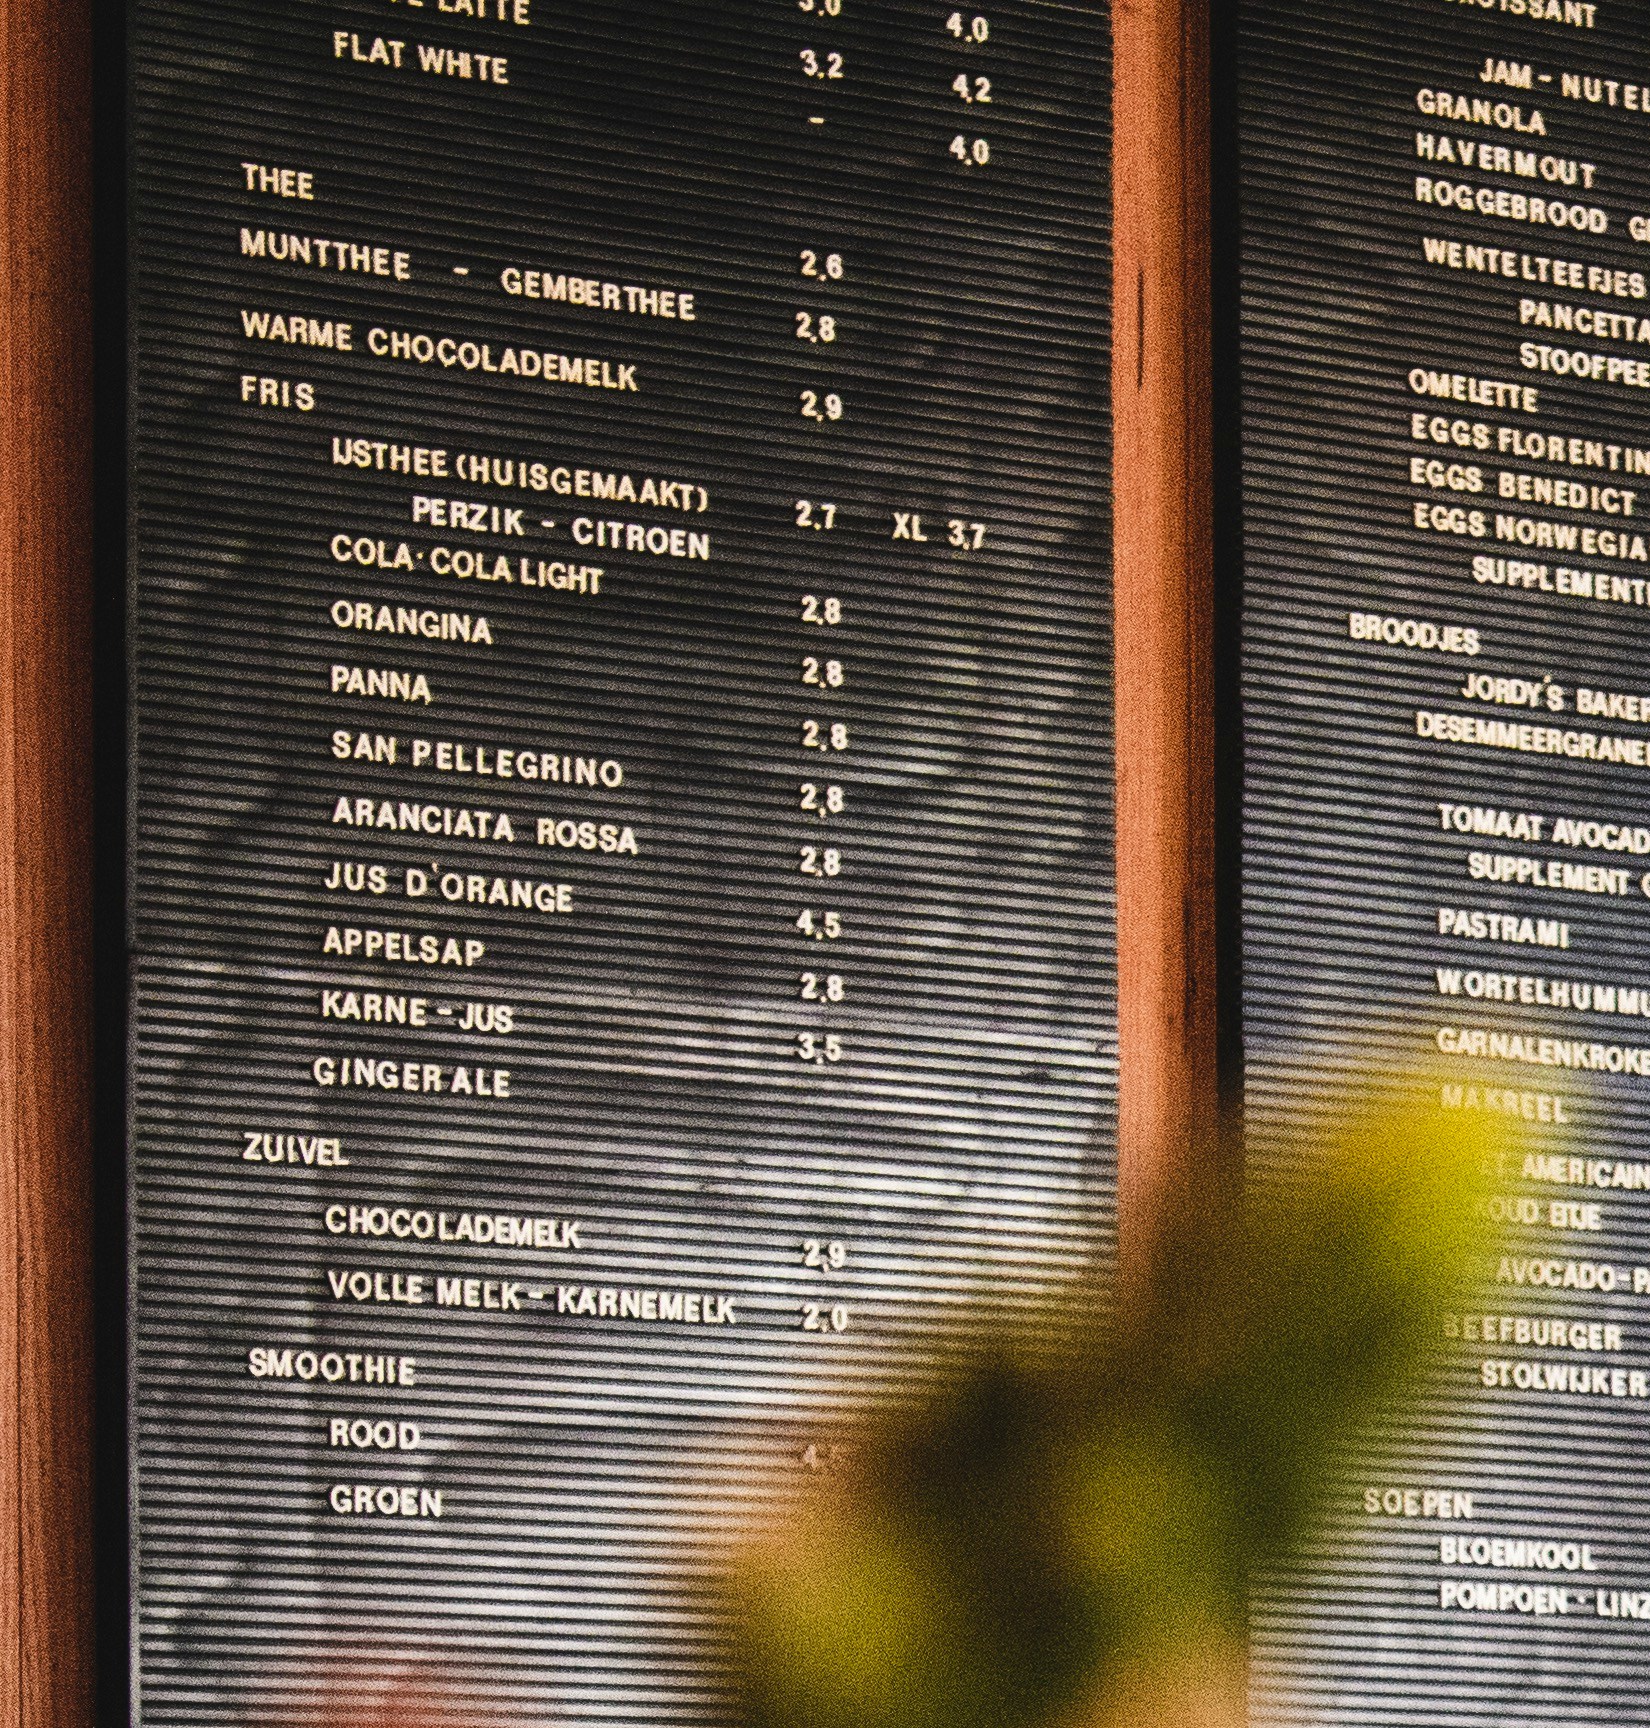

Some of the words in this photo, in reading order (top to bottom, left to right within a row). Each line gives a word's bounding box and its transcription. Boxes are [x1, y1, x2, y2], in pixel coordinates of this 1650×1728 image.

[333, 31, 405, 69] FLAT
[418, 44, 509, 84] WHITE
[1480, 58, 1532, 89] JAM
[1416, 88, 1546, 136] GRANOLA
[241, 162, 314, 200] THEE
[1415, 133, 1597, 189] HAVERMOUT
[1415, 177, 1608, 235] ROGGEBROOD
[241, 228, 411, 282] MUNTTHEE
[500, 268, 696, 321] GEMBERTHEE
[1422, 236, 1647, 300] WENTELTEEFJES
[241, 310, 352, 351] WARME
[367, 328, 638, 392] CHOCOLADEMELK
[240, 375, 315, 412] FRIS
[1409, 368, 1538, 413] OMELETTE
[1411, 413, 1490, 452] EGGS
[456, 453, 709, 514] (HUISGEMAAKT)
[1410, 457, 1483, 495] EGGS
[1498, 472, 1637, 517] BENEDICT
[412, 495, 525, 539] PERZIK
[572, 516, 710, 561] CITROEN
[891, 511, 927, 543] XL
[1413, 502, 1486, 539] EGGS
[430, 547, 513, 583] COLA
[519, 558, 604, 595] LIGHT
[330, 600, 493, 646] ORANGINA
[1349, 612, 1480, 656] BROODJES
[330, 663, 432, 707] PANNA
[1461, 673, 1564, 712] JORDY'S
[331, 730, 395, 765] SAN
[412, 740, 623, 789] PELLEGRINO
[332, 797, 515, 844] ARANCIATA
[536, 818, 639, 858] ROSSA
[1437, 803, 1545, 842] TOMAAT
[324, 862, 388, 896] JUS
[406, 862, 574, 915] D'ORANGE
[1468, 852, 1630, 896] SUPPLEMENT
[323, 927, 485, 969] APPELSAP
[1437, 908, 1570, 949] PASTRAMI
[322, 990, 427, 1026] KARNE
[313, 1057, 442, 1093] GINGER
[450, 1066, 510, 1098] ALE
[1441, 1084, 1568, 1123] MAKREEL
[243, 1131, 349, 1169] ZUIVEL
[325, 1205, 582, 1252] CHOCOLADEMELK
[1550, 1201, 1602, 1231] EITJE
[329, 1270, 424, 1306] VOLLE
[437, 1276, 520, 1313] MELK
[557, 1284, 737, 1327] KARNEMELK
[1443, 1313, 1623, 1351] BEEFBURGER
[247, 1347, 416, 1387] SMOOTHIE
[1480, 1360, 1649, 1398] STOLWIJKER
[329, 1417, 421, 1454] ROOD
[329, 1484, 443, 1520] GROEN
[1363, 1487, 1473, 1520] SOEPEN
[1440, 1537, 1598, 1571] BLOEMKOOL
[1440, 1581, 1569, 1615] POMPOEN
